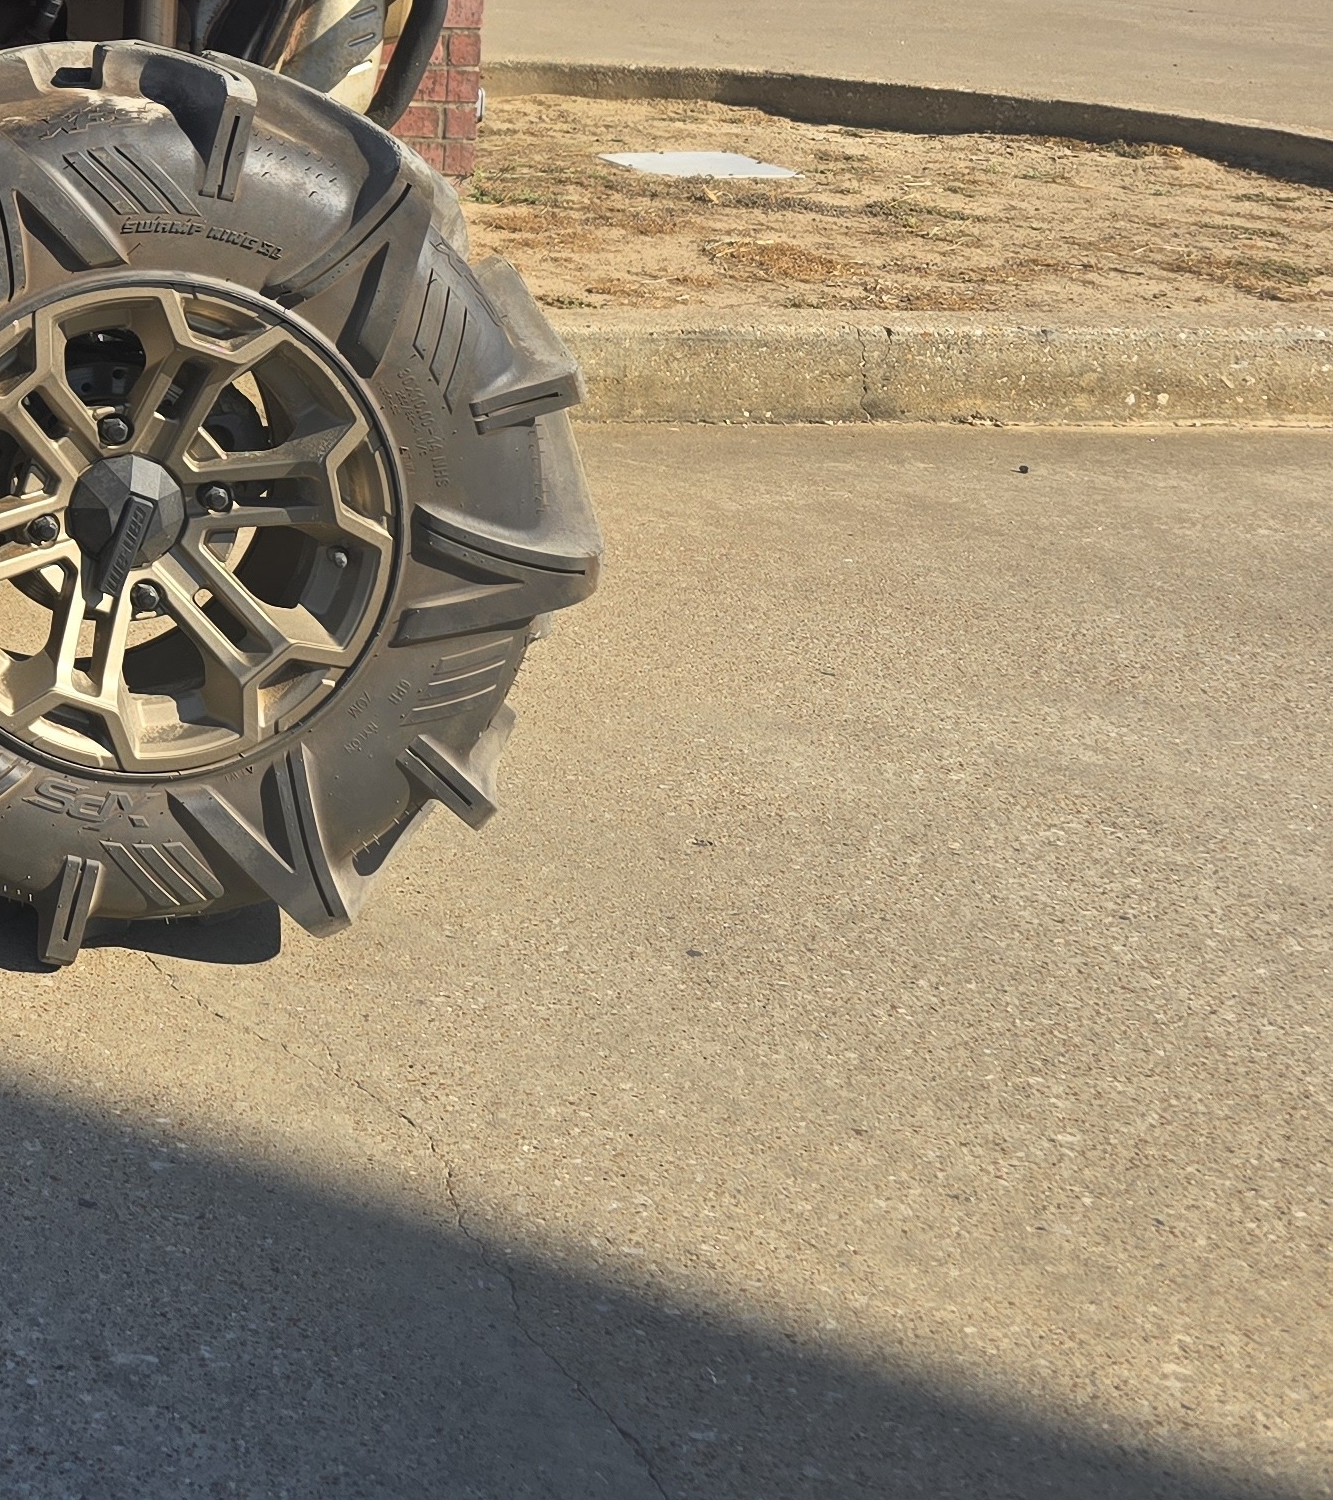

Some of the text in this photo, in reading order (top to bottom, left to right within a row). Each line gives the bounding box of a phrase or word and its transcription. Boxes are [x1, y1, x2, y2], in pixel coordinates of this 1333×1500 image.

[120, 217, 205, 235] SWAMP
[206, 226, 259, 250] KING
[21, 776, 162, 832] XPS
